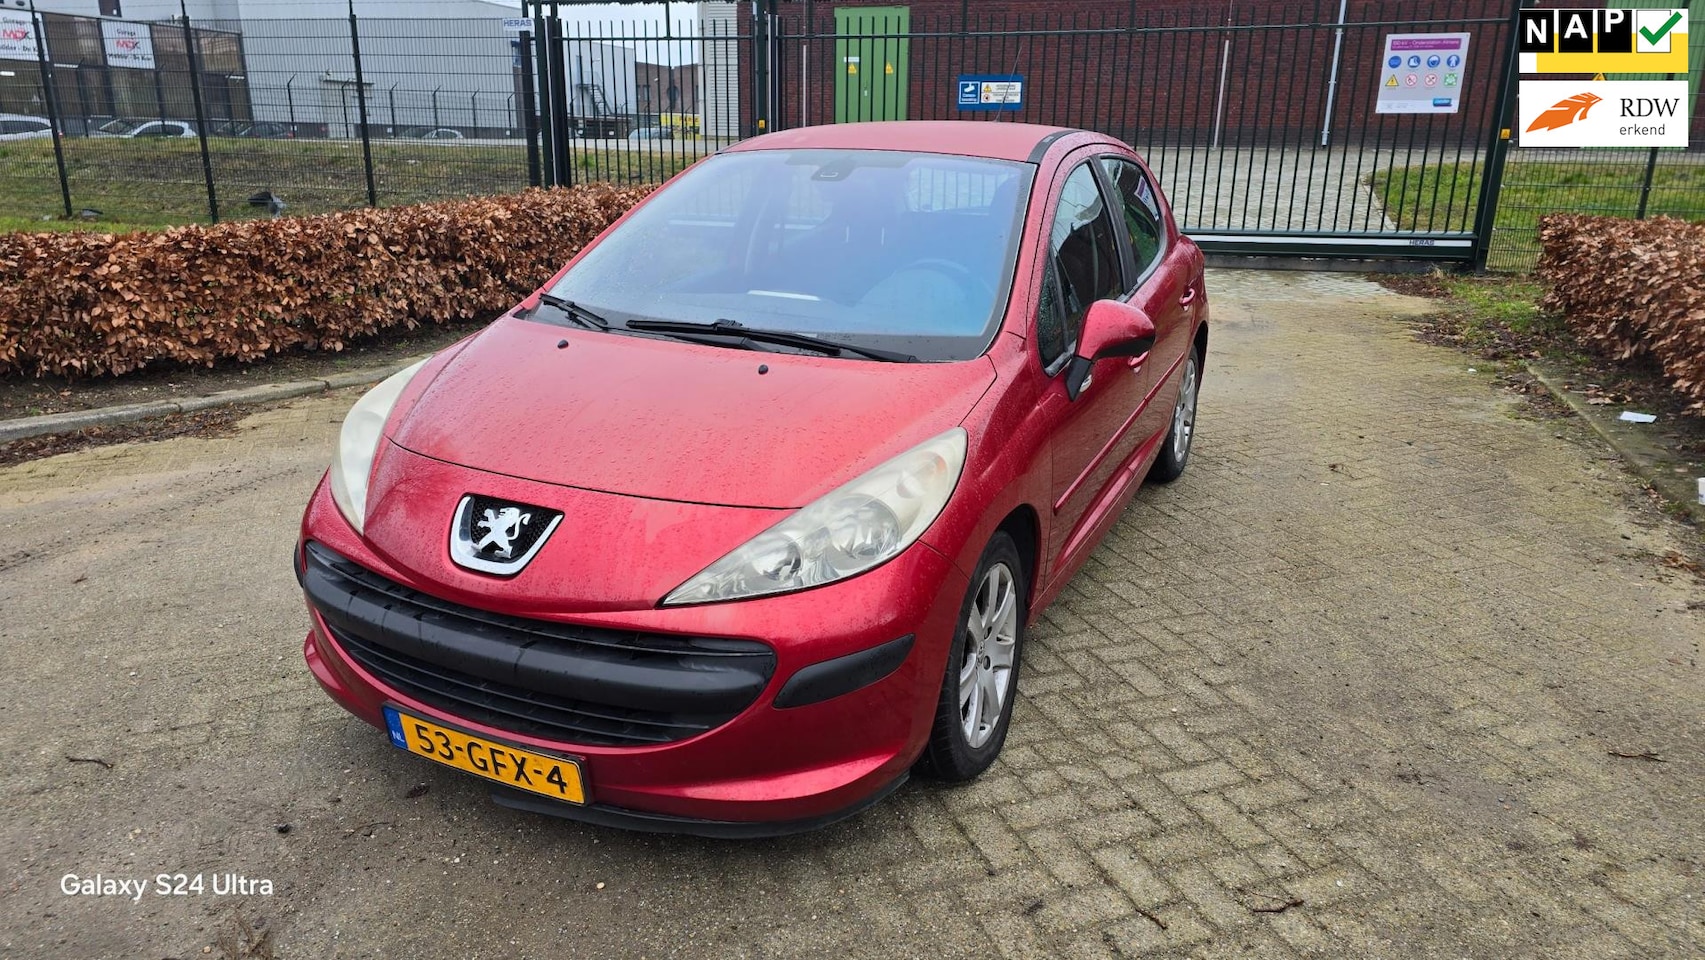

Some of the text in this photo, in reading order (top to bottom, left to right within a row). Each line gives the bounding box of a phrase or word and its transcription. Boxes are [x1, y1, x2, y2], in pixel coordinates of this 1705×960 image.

[503, 19, 532, 27] HERAS
[391, 730, 405, 743] NL
[414, 723, 568, 794] 53-GFX-4
